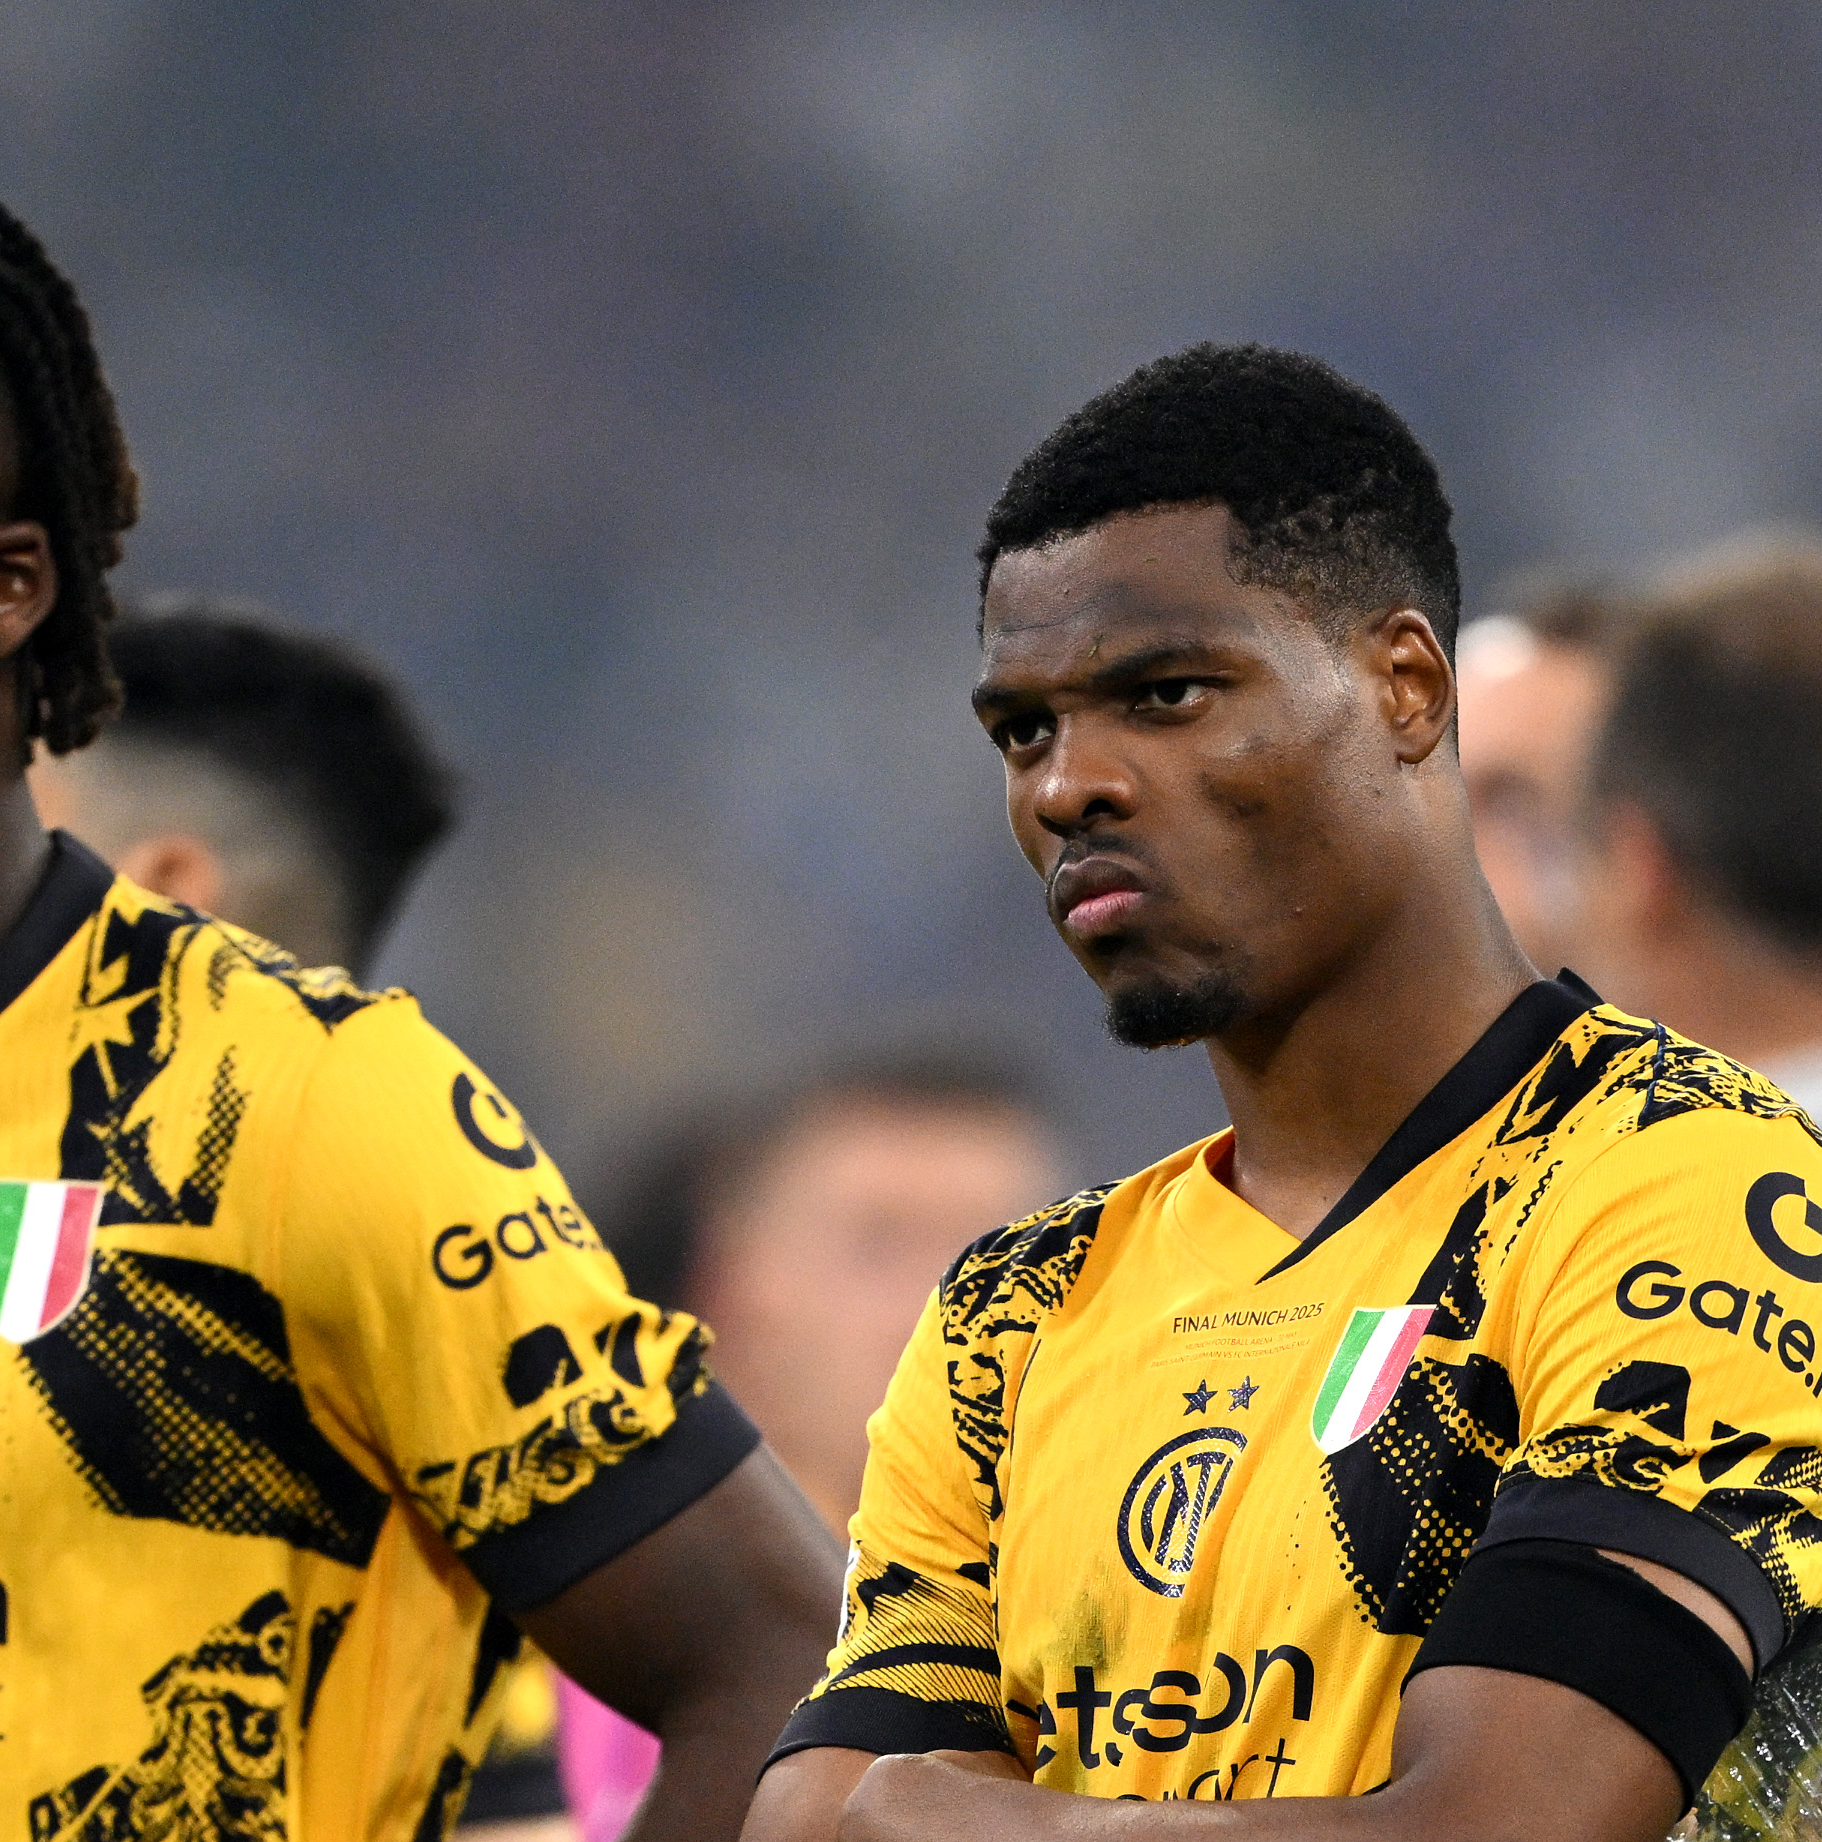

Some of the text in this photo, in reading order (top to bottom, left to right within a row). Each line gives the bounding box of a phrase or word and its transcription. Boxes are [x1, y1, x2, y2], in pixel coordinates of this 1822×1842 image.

[1172, 1302, 1325, 1334] FINAL MUNICH 2025
[1211, 1337, 1249, 1347] FOOTBALL
